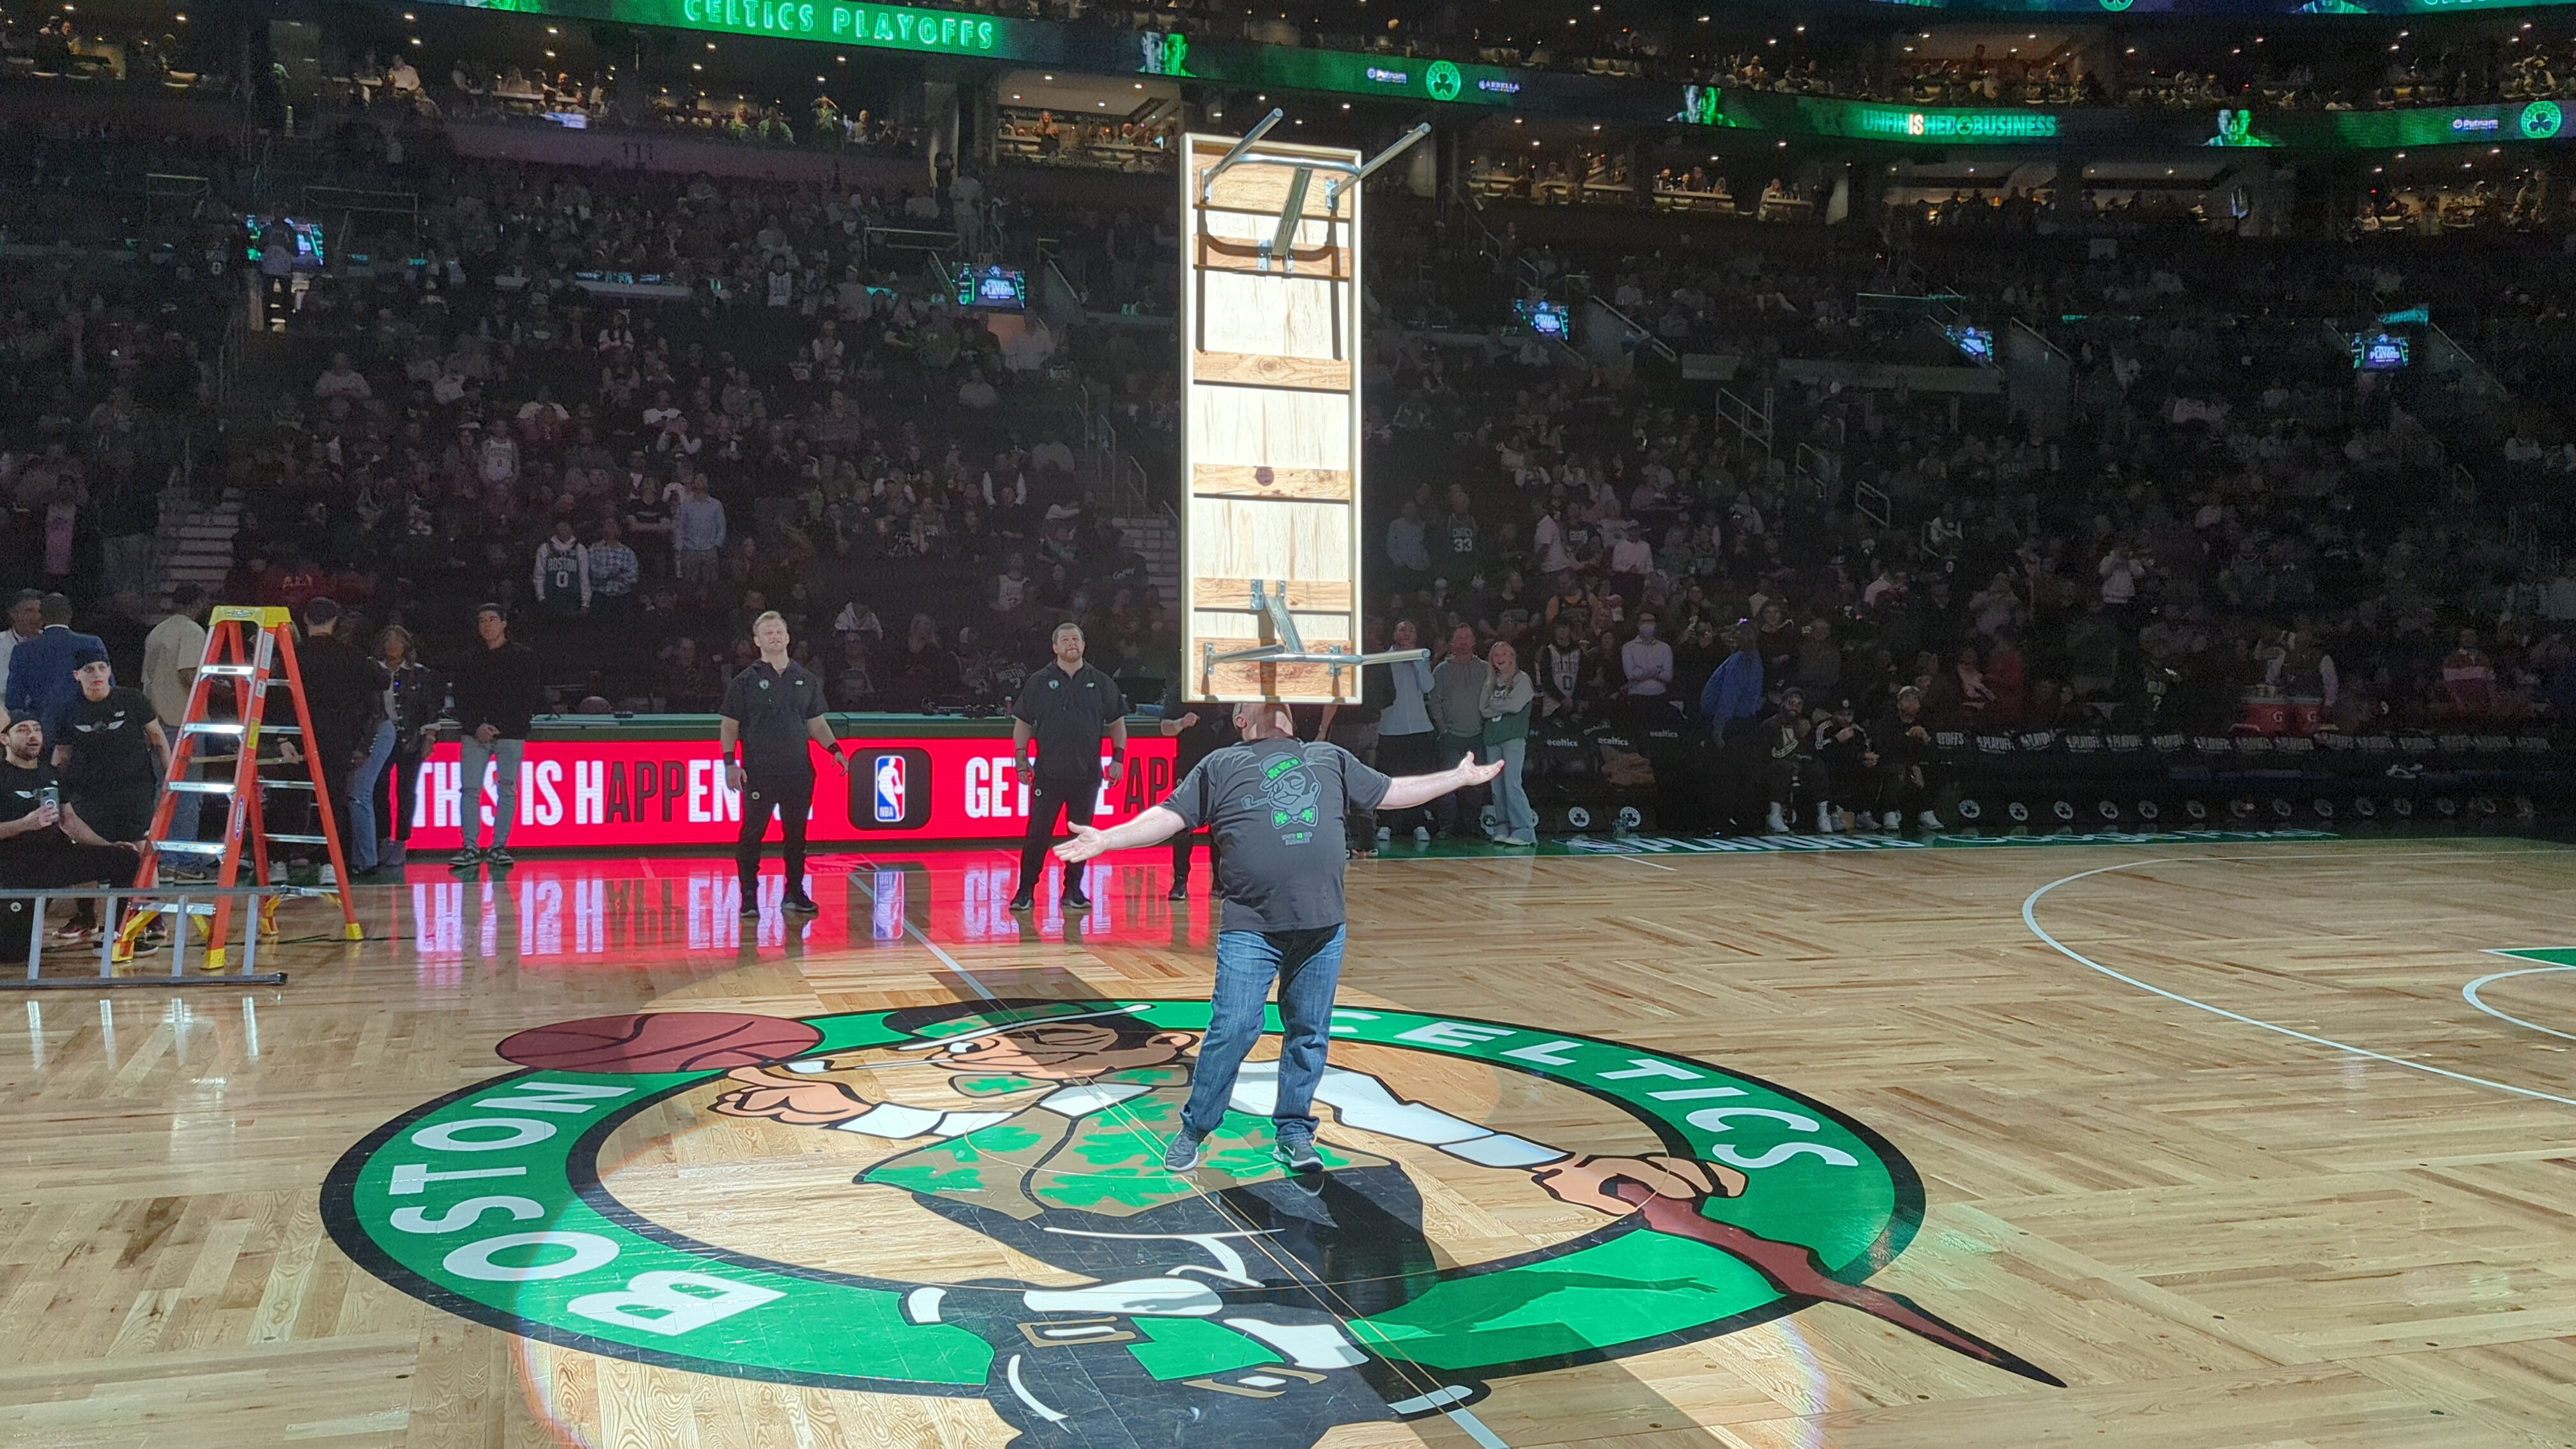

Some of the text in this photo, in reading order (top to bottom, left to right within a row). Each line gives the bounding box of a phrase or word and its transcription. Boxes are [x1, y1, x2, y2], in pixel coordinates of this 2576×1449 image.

[684, 0, 992, 49] CELTICS PLAYOFFS
[1862, 110, 2057, 137] UNFINISHED BUSINESS
[1453, 538, 1473, 552] 33
[548, 557, 577, 573] BOSTON
[556, 571, 569, 588] 0
[2273, 711, 2283, 723] G
[521, 760, 564, 826] IS
[1123, 756, 1177, 815] AP
[879, 806, 894, 818] NBA
[1615, 834, 1925, 852] PLAYOFFS
[390, 1081, 788, 1337] BOSTON
